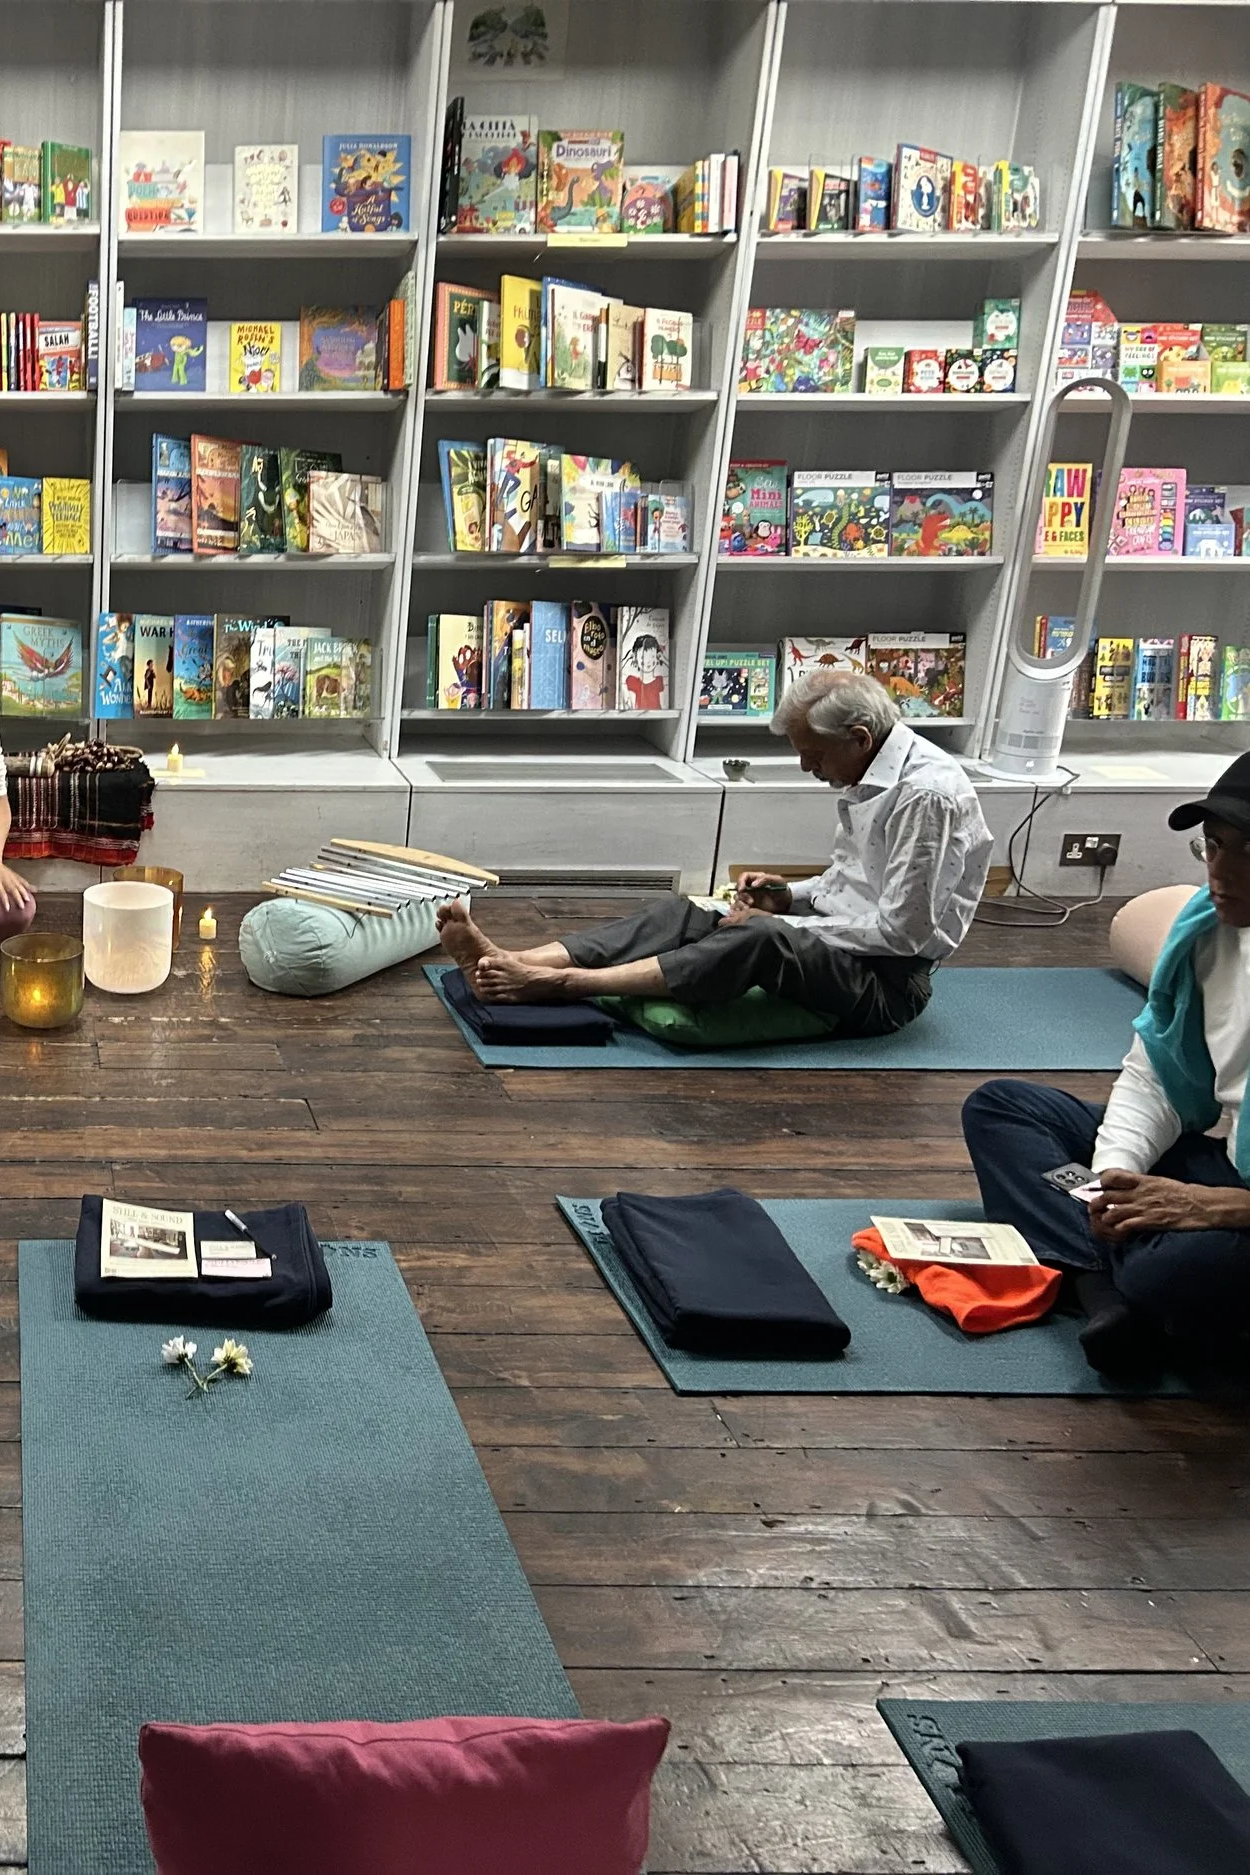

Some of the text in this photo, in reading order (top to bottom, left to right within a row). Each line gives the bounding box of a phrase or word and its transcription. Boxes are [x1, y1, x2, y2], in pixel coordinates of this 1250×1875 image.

[339, 142, 399, 151] JULIA DONALDSON
[556, 144, 612, 159] Dinosauri
[140, 308, 204, 322] The Little Prince
[237, 325, 275, 335] MICHAEL
[44, 334, 70, 348] SALAH
[797, 473, 853, 481] FLOOR PUZZLE
[751, 488, 782, 501] Mini
[334, 530, 363, 542] JAPAN
[1059, 531, 1085, 543] FACES
[23, 625, 54, 638] GREEK
[140, 626, 167, 638] WAR
[224, 619, 268, 634] The Wind
[31, 637, 66, 649] MYTHS
[314, 642, 331, 654] JACK
[729, 659, 756, 667] PUZZLE
[113, 1205, 183, 1225] STILL & SOUND
